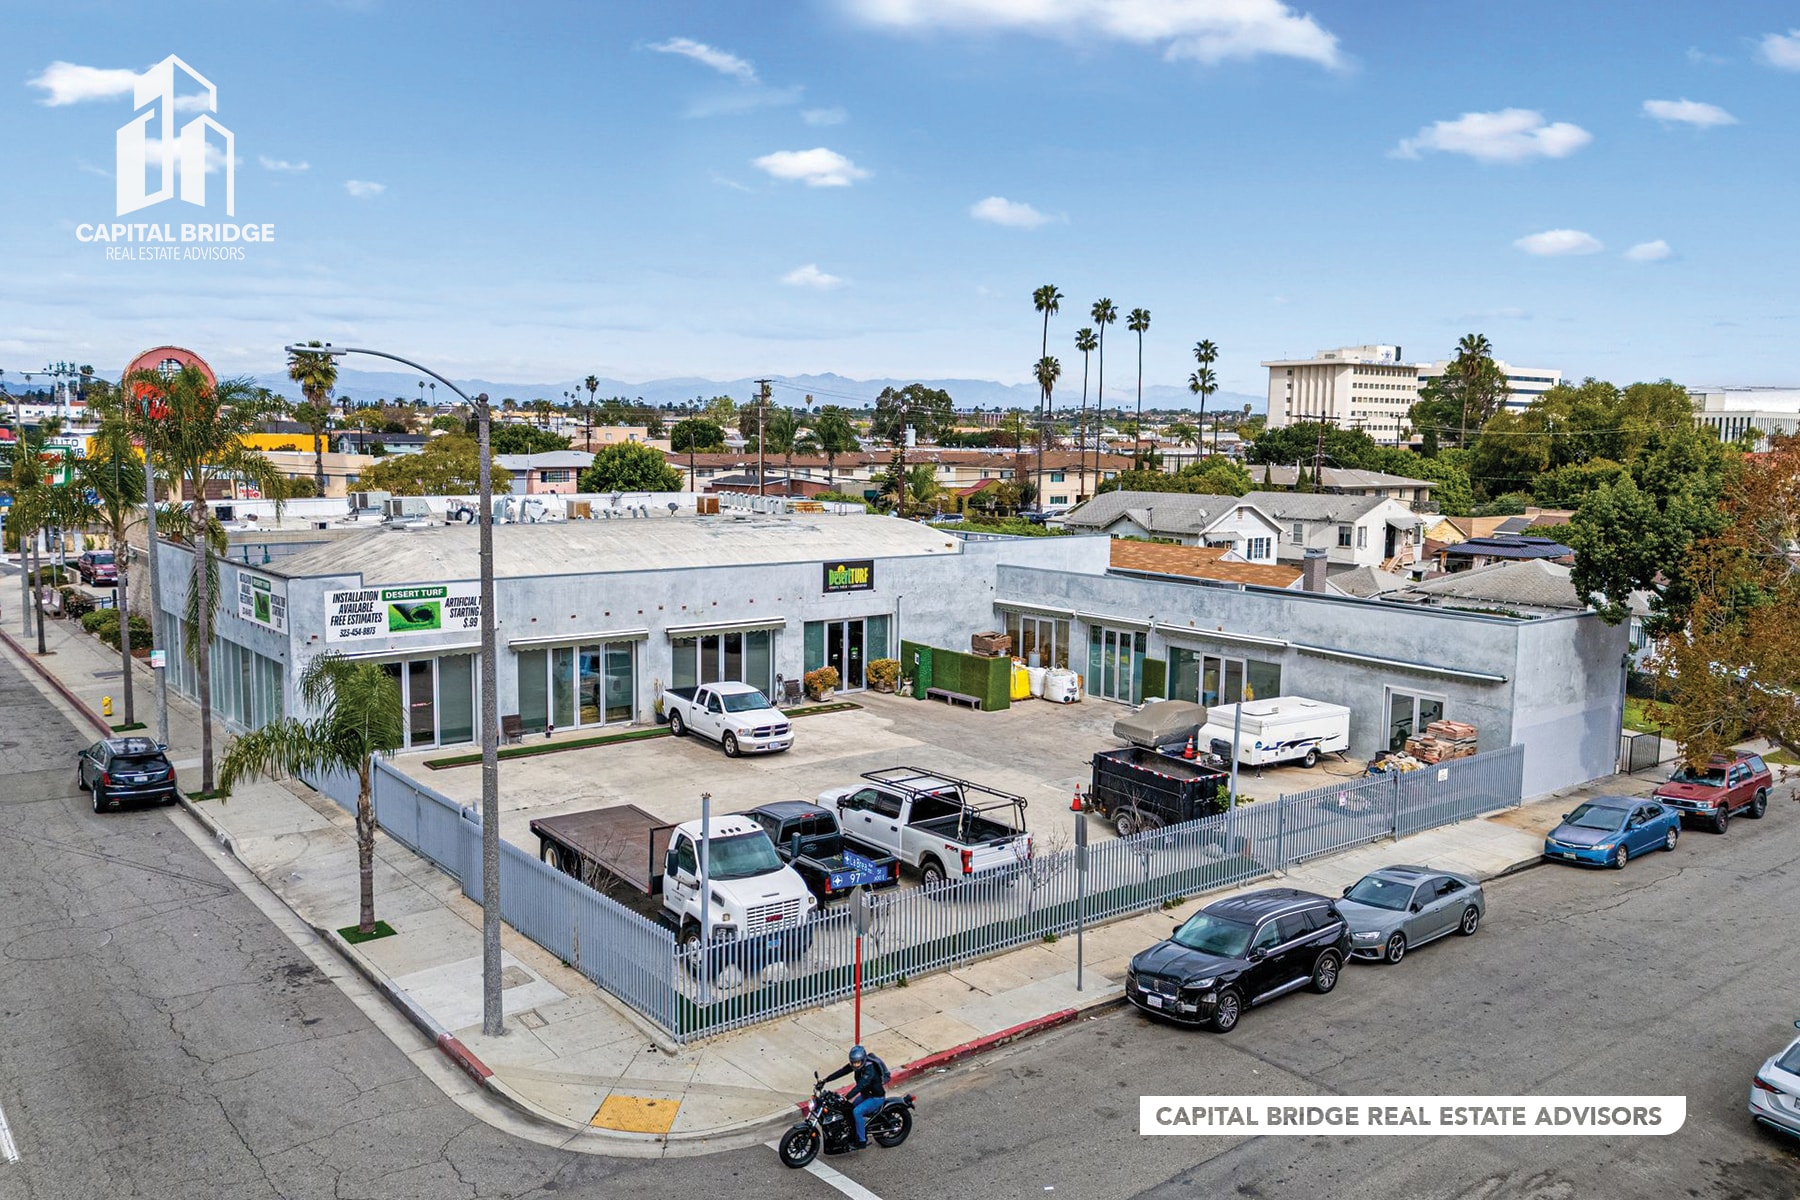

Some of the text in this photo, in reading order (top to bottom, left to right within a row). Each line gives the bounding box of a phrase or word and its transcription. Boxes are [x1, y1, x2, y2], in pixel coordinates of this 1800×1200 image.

[332, 590, 379, 604] INSTALLATION
[386, 588, 443, 599] DESERT TURF
[338, 602, 373, 614] AVAILABLE
[444, 596, 477, 608] ARTIFICIAL
[449, 606, 479, 618] STARTING
[330, 612, 383, 626] FREE ESTIMATES
[462, 617, 478, 628] $.99
[850, 872, 861, 884] 97
